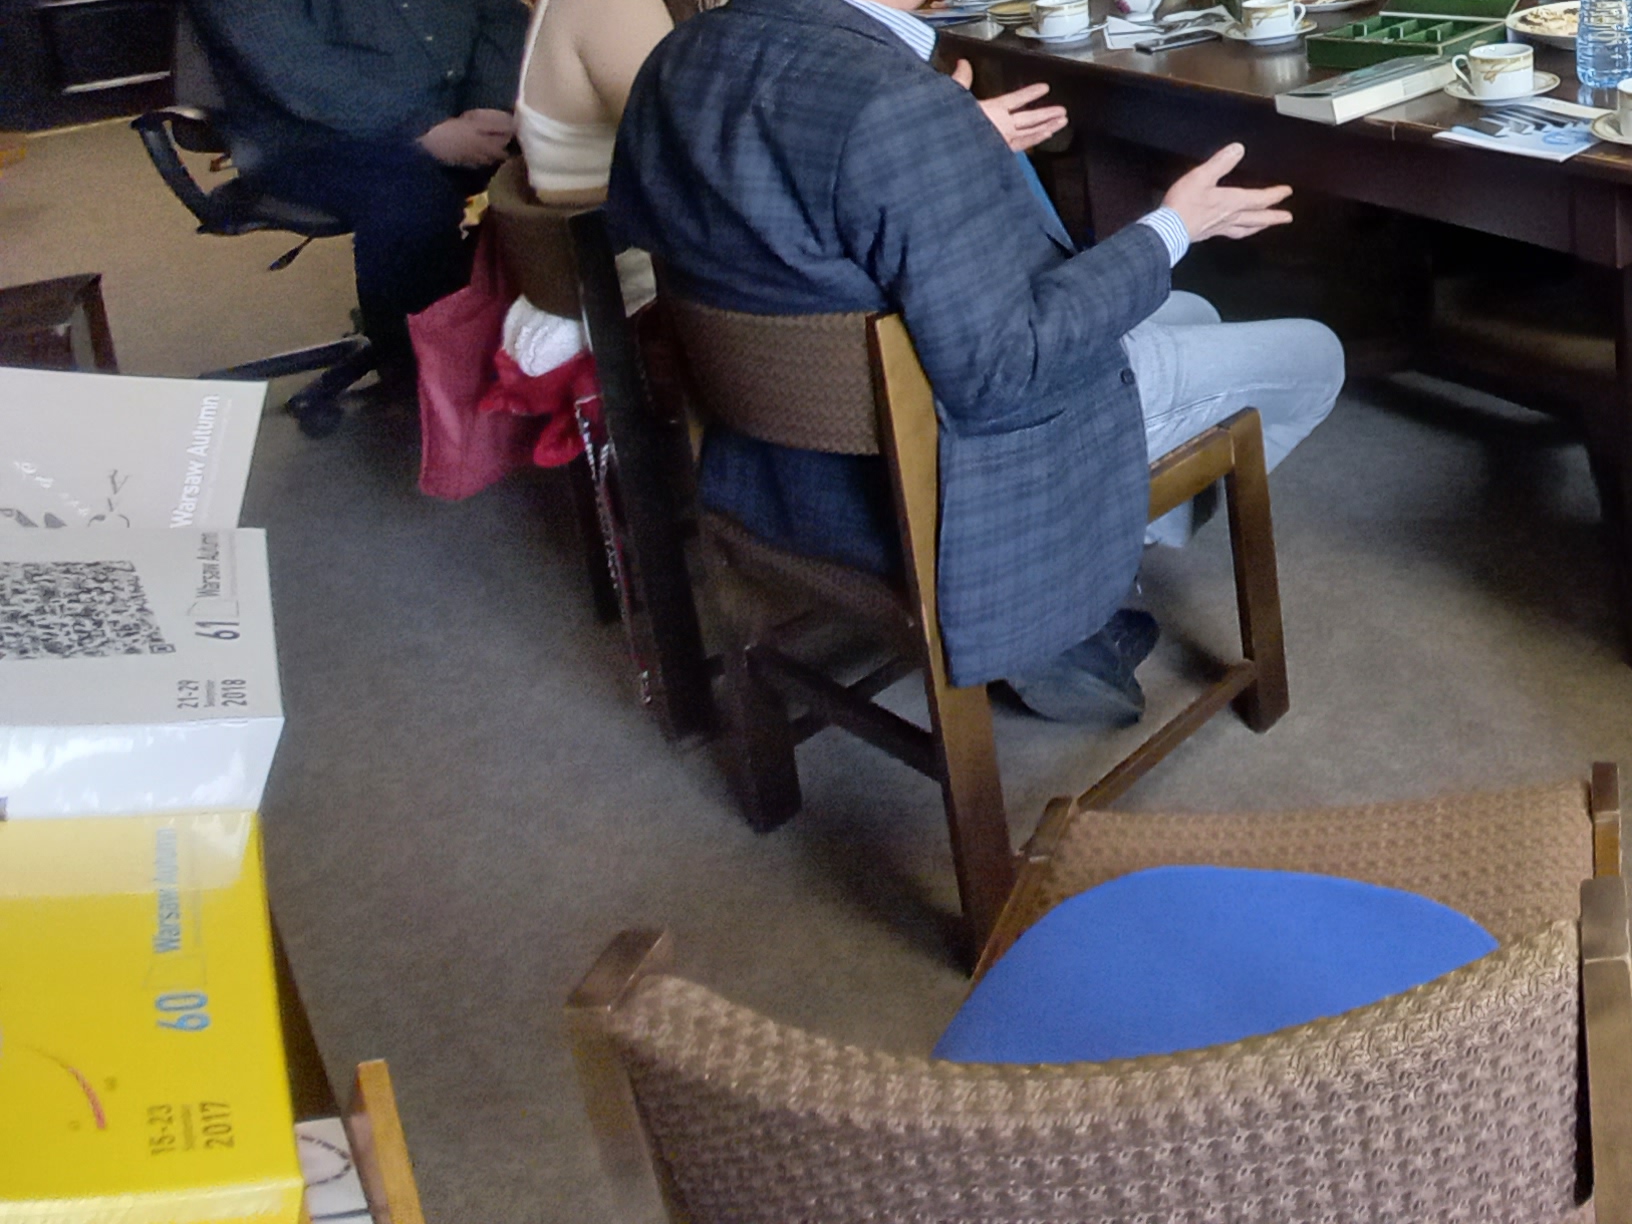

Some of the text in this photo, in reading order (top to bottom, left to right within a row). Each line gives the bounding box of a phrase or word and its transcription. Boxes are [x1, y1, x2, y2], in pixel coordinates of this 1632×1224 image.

[170, 395, 221, 528] Warsaw Autumn
[196, 563, 221, 598] Warsaw
[195, 621, 240, 640] 61
[177, 679, 200, 710] 21-29
[221, 679, 248, 708] 2018
[152, 888, 181, 954] Warsaw
[155, 993, 210, 1032] 60
[147, 1103, 177, 1156] 15-23
[199, 1101, 235, 1150] 2017
